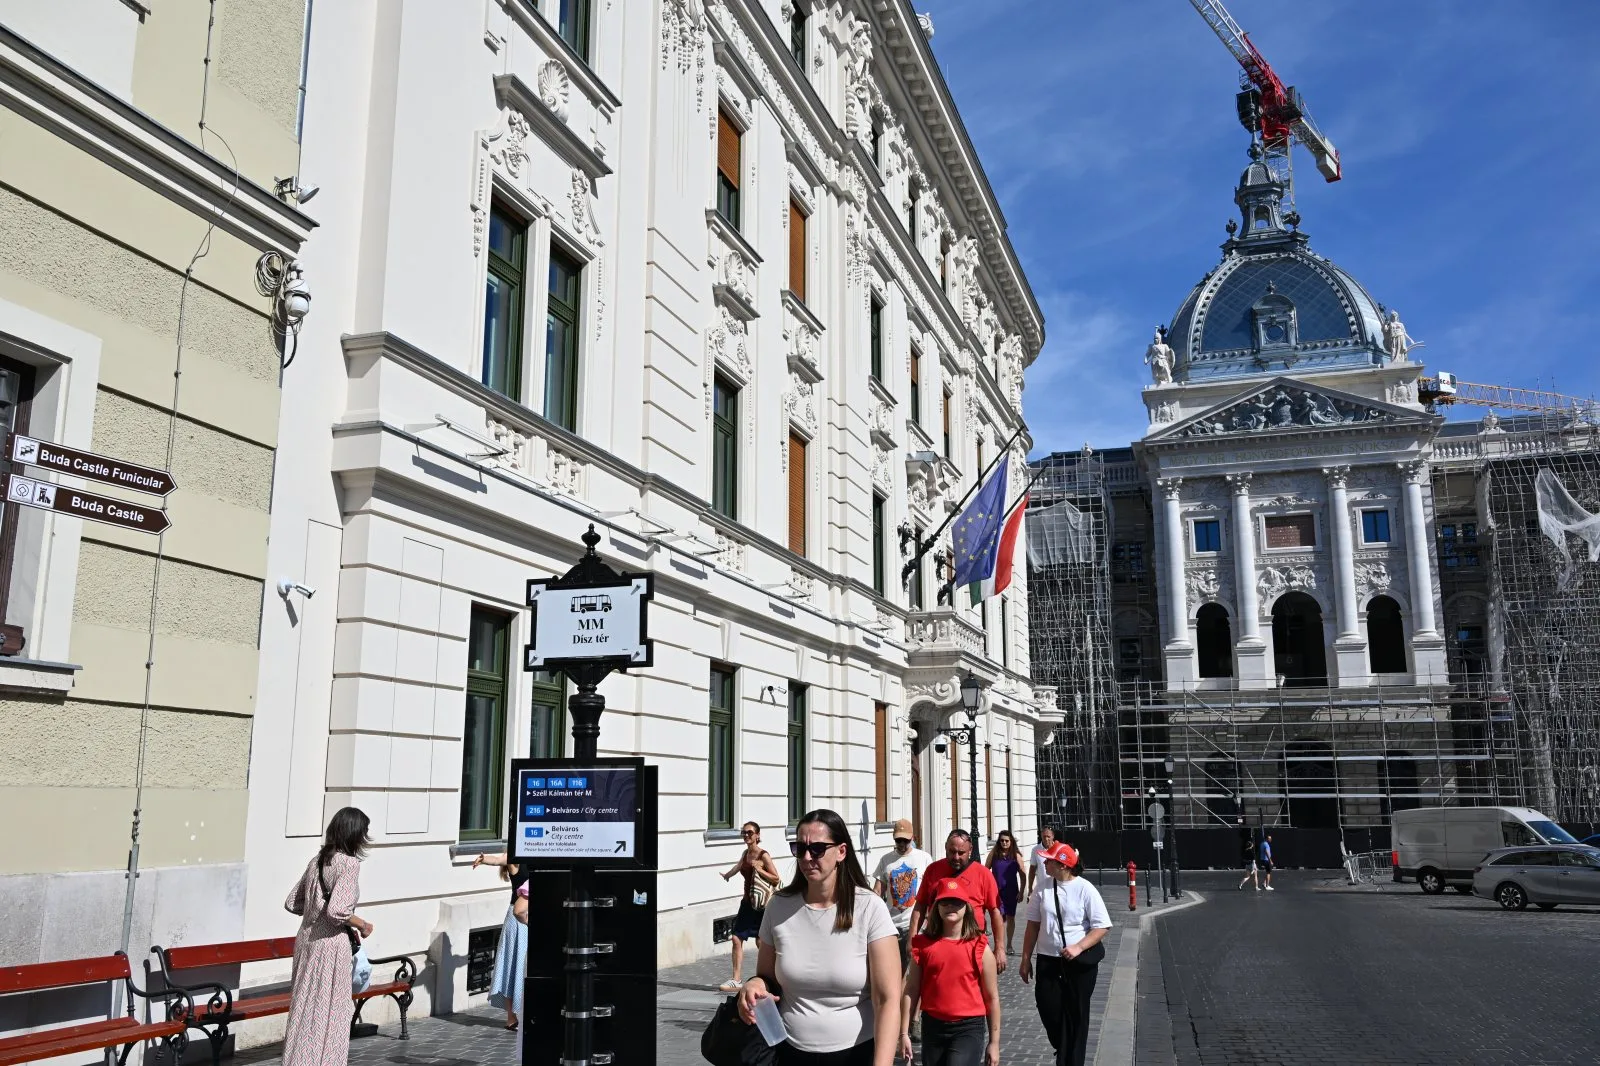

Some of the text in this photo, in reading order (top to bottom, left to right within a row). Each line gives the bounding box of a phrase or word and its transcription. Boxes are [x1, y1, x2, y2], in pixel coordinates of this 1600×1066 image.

[40, 450, 164, 489] Buda Castle Funicular
[72, 496, 144, 522] Buda Castle
[578, 618, 604, 630] MM
[572, 634, 610, 644] Dísz tér
